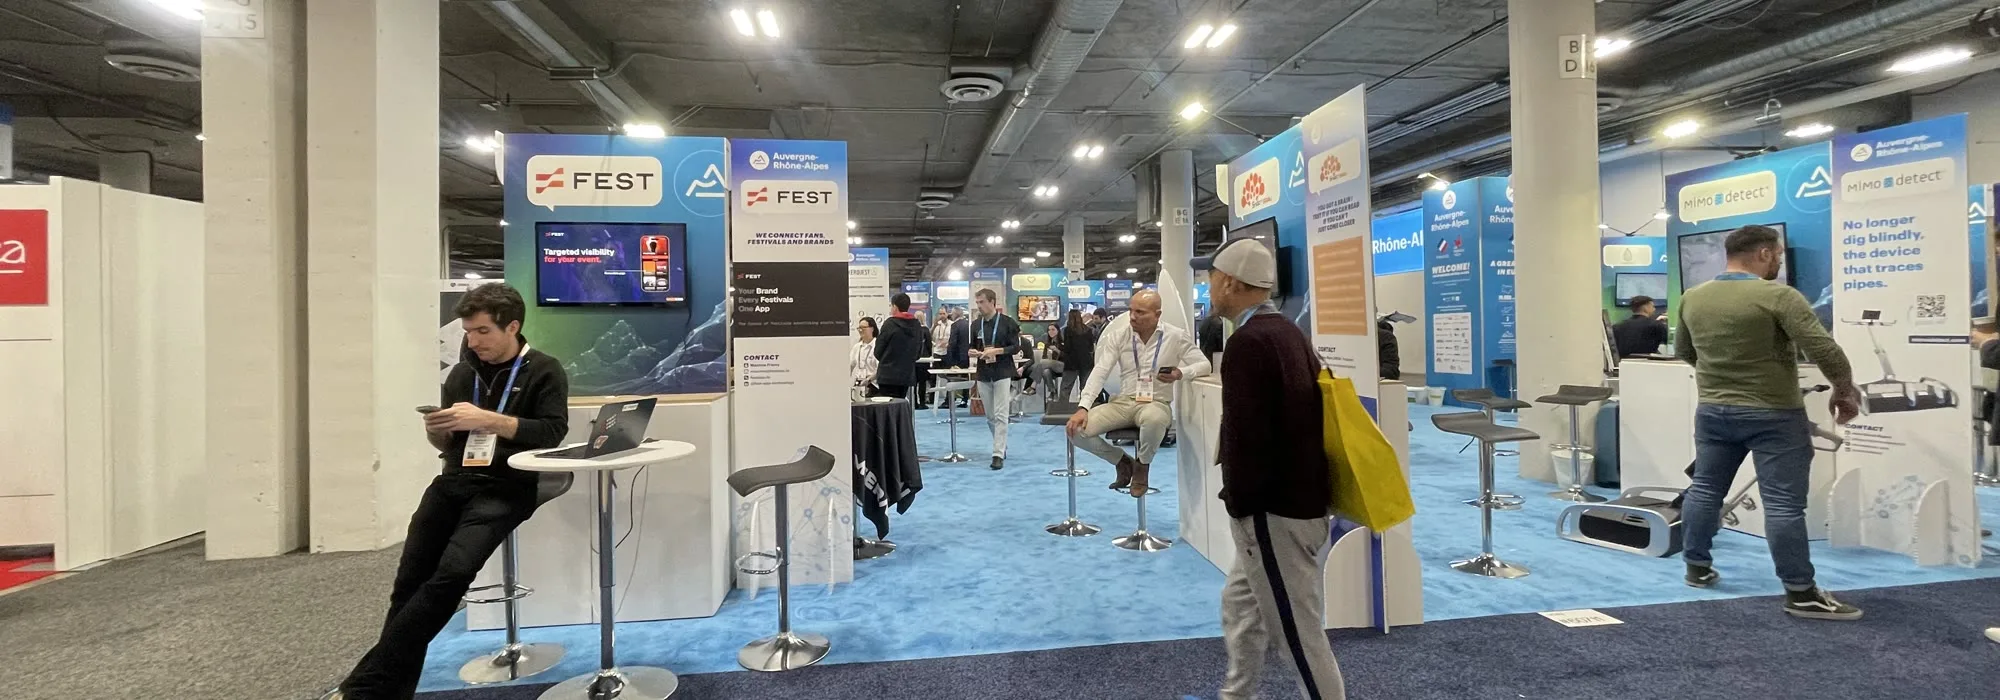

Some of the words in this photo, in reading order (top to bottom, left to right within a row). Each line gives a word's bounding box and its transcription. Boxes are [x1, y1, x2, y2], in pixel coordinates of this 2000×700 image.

[1570, 41, 1579, 53] B
[773, 152, 819, 162] Auvergne-
[773, 162, 829, 171] Rhône-Alpes
[573, 172, 654, 190] FEST
[778, 191, 832, 204] FEST
[1434, 210, 1466, 222] Auvergne-
[1431, 219, 1469, 232] Rhône-Alpes
[1843, 220, 1862, 230] No
[1866, 216, 1916, 228] longer
[1843, 235, 1866, 246] dig
[544, 248, 580, 256] Targeted
[581, 248, 615, 256] visibility
[1843, 250, 1866, 260] the
[1870, 246, 1921, 258] device
[1432, 262, 1470, 274] WELCOME!
[1844, 265, 1872, 274] that
[1876, 262, 1924, 272] traces
[1844, 280, 1888, 291] pipes.
[1845, 424, 1884, 432] CONTACT
